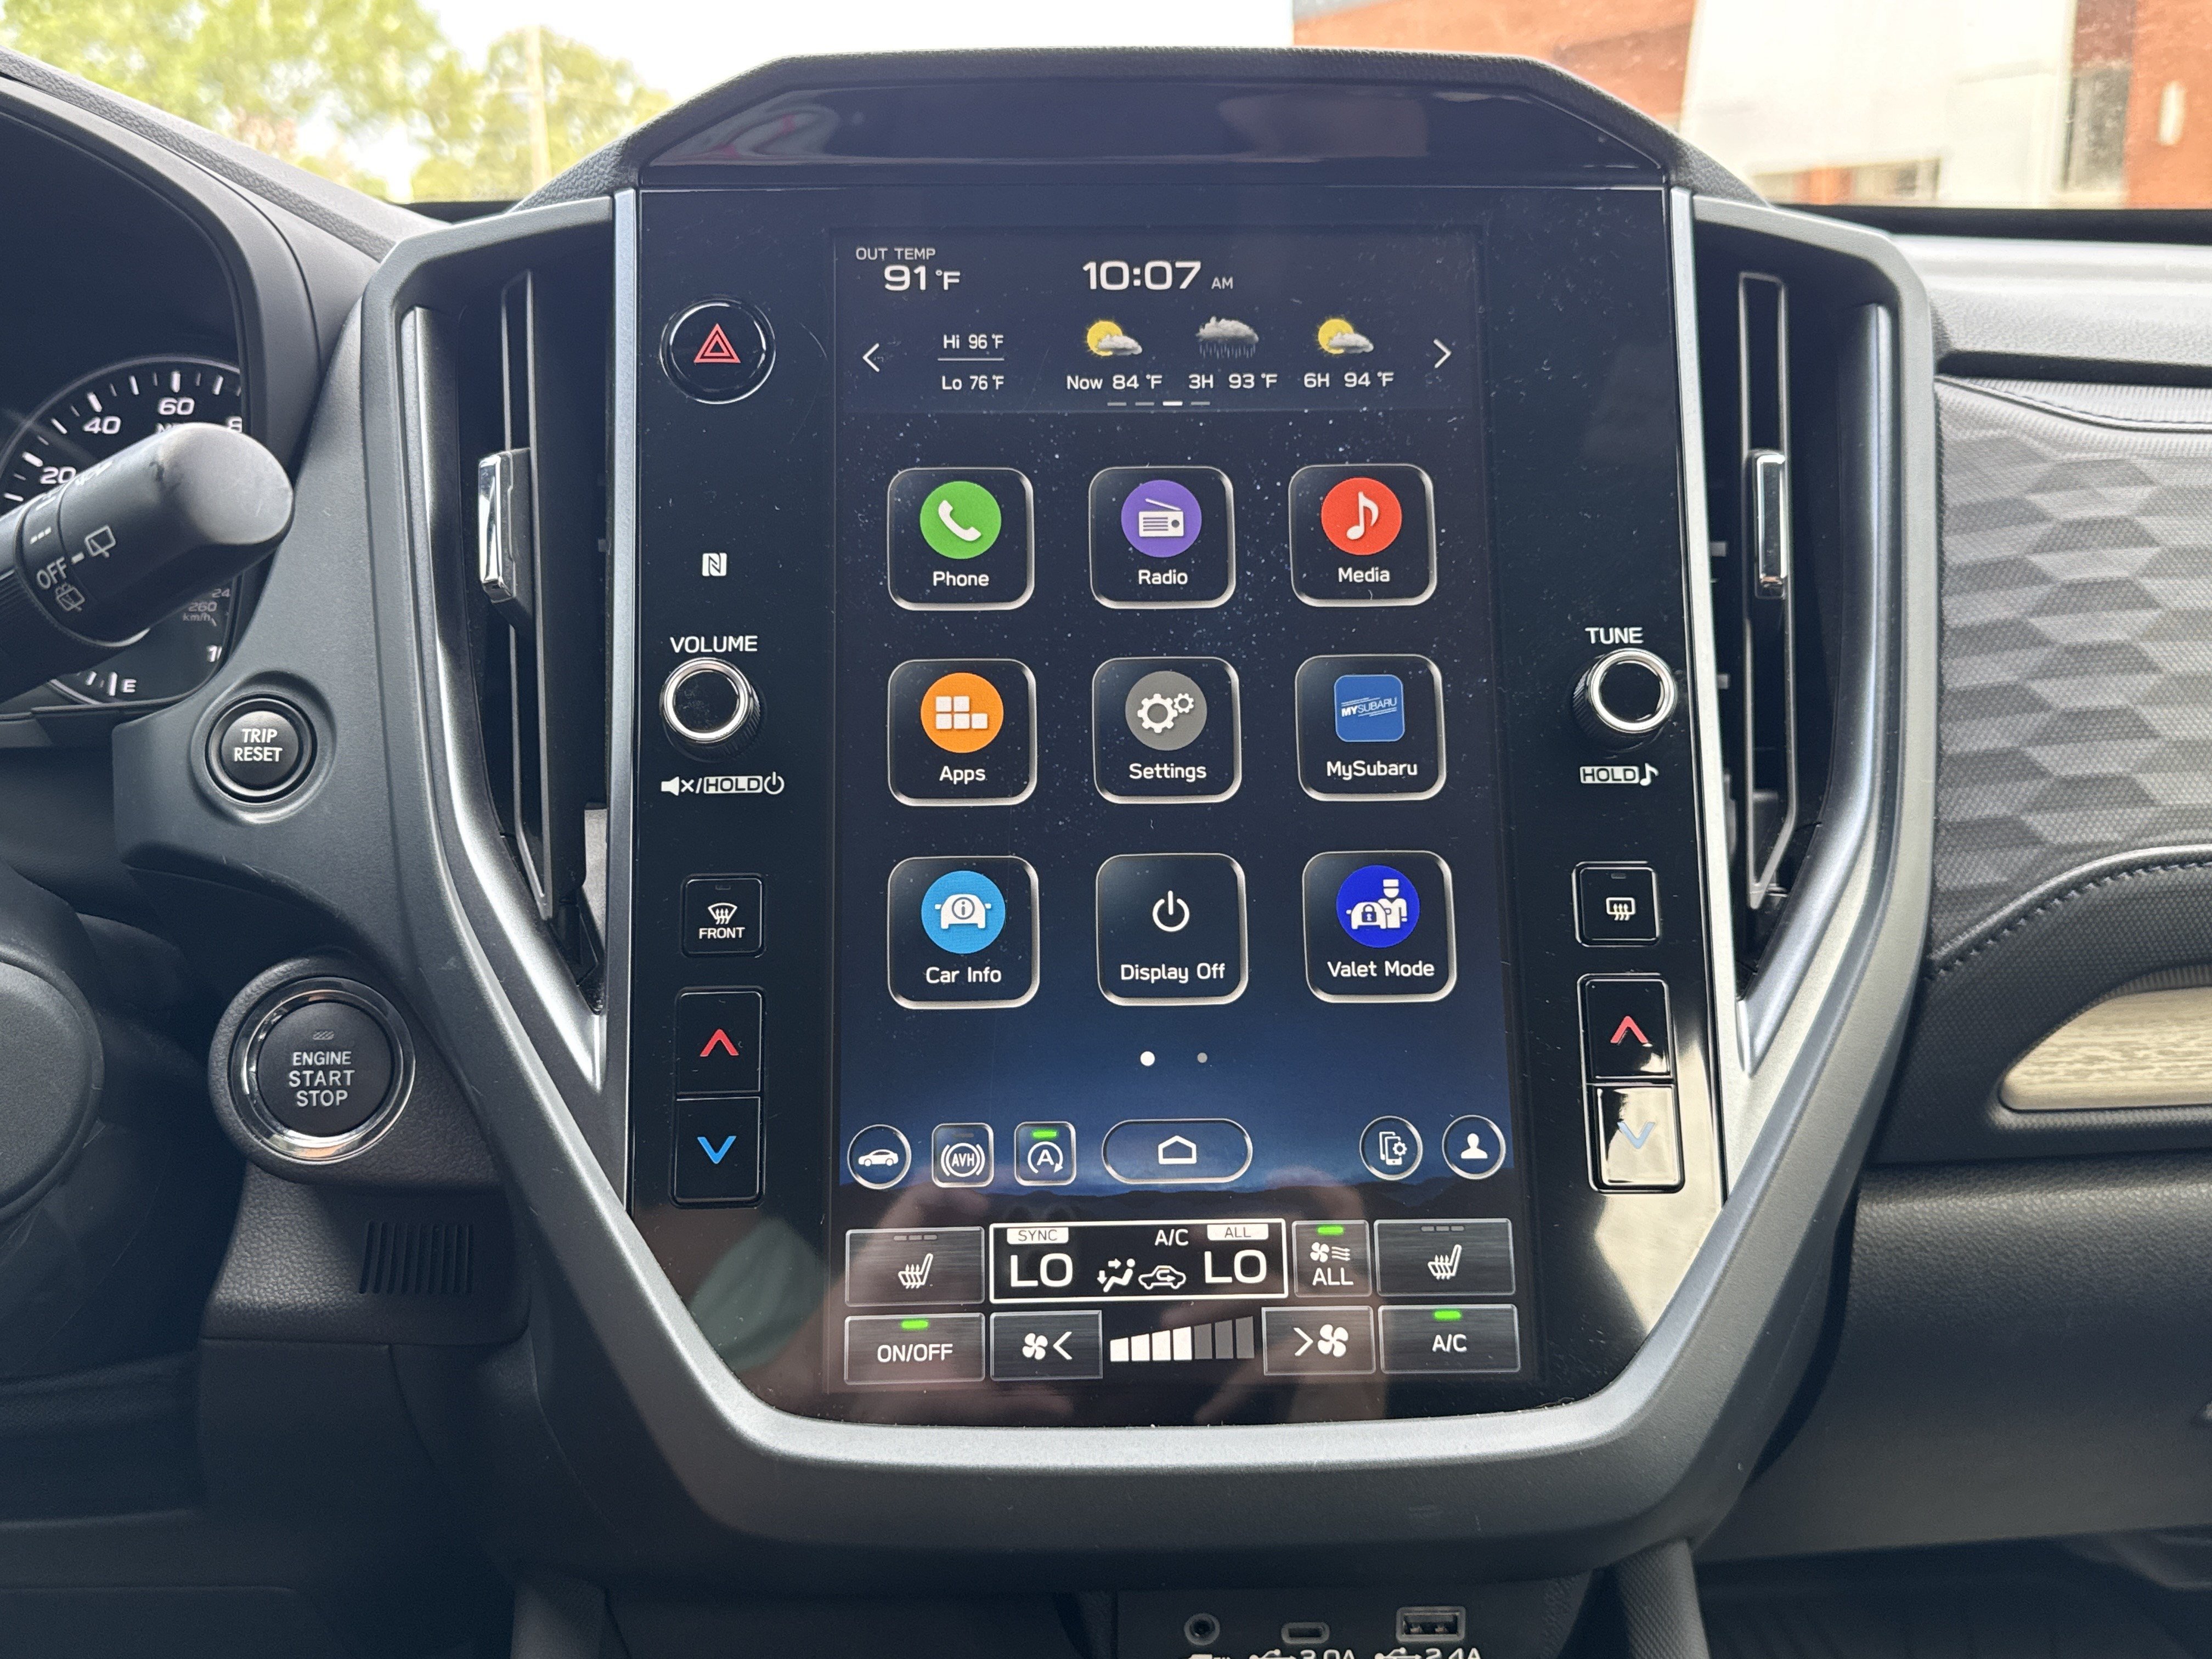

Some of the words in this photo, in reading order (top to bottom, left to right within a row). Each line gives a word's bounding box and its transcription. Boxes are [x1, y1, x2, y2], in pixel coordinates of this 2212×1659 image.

[856, 247, 888, 260] OUT
[894, 247, 936, 260] TEMP
[884, 265, 926, 291] 91
[935, 269, 961, 290] °F
[1082, 261, 1201, 290] 10:07
[1211, 277, 1233, 290] AM
[943, 334, 960, 349] Hi
[968, 334, 988, 349] 96
[942, 375, 962, 391] Lo
[969, 375, 988, 391] 76
[1066, 375, 1103, 390] Now
[1112, 375, 1139, 390] 84
[1188, 374, 1214, 389] 3H
[1228, 373, 1255, 389] 93
[1304, 373, 1330, 388] 6H
[1344, 372, 1371, 387] 94
[159, 397, 194, 415] 60
[83, 415, 121, 435] 40
[40, 466, 76, 484] 20
[36, 556, 66, 590] OFF
[933, 571, 989, 586] Phone
[1138, 569, 1188, 585] Radio
[1338, 567, 1390, 583] Media
[188, 601, 217, 612] 260
[670, 635, 758, 653] VOLUME
[1585, 627, 1644, 644] TUNE
[123, 679, 137, 692] E
[241, 727, 278, 744] TRIP
[234, 747, 283, 763] RESET
[939, 765, 986, 785] Apps
[1129, 763, 1207, 782] Settings
[1327, 760, 1418, 781] MySubaru
[1582, 768, 1637, 782] HOLD
[704, 777, 762, 792] HOLD
[699, 927, 746, 939] FRONT
[926, 967, 960, 984] Car
[968, 966, 1001, 983] Info
[1121, 963, 1188, 984] Display
[1197, 962, 1225, 979] Off
[1327, 961, 1377, 978] Valet
[1384, 960, 1435, 977] Mode
[292, 1051, 351, 1066] ENGINE
[289, 1070, 355, 1087] START
[296, 1090, 348, 1107] STOP
[951, 1153, 975, 1167] AVH
[1036, 1149, 1054, 1166] A
[1018, 1229, 1058, 1241] SYNC
[1154, 1228, 1189, 1246] A/C
[1224, 1226, 1251, 1238] ALL
[1011, 1253, 1073, 1287] LO
[1204, 1249, 1267, 1284] LO
[1312, 1267, 1354, 1286] ALL
[1432, 1334, 1467, 1352] A/C
[877, 1344, 953, 1363] ON/OFF
